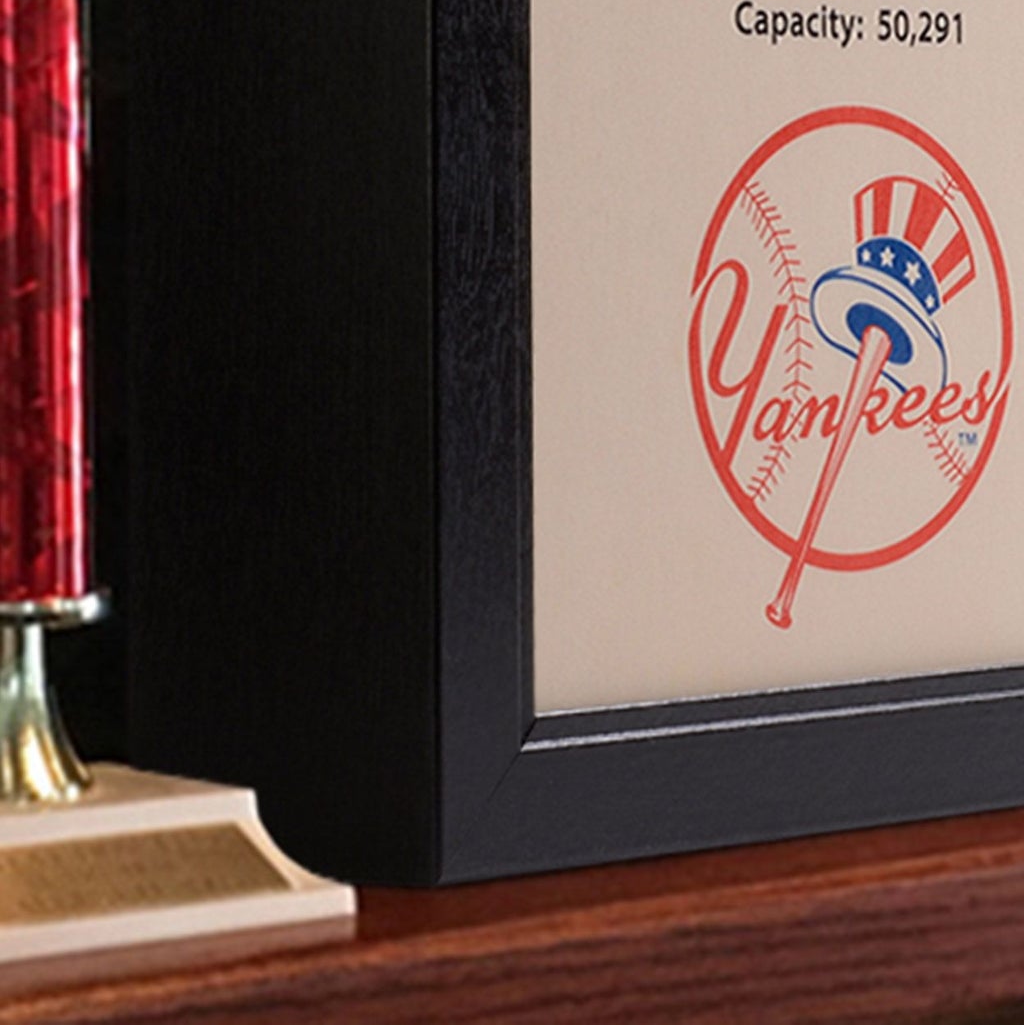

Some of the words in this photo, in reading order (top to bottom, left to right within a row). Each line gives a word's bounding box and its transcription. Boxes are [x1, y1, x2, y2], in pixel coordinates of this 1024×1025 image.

[734, 0, 864, 49] Capacity:
[877, 9, 962, 47] 50,291
[689, 258, 1009, 467] Yankees
